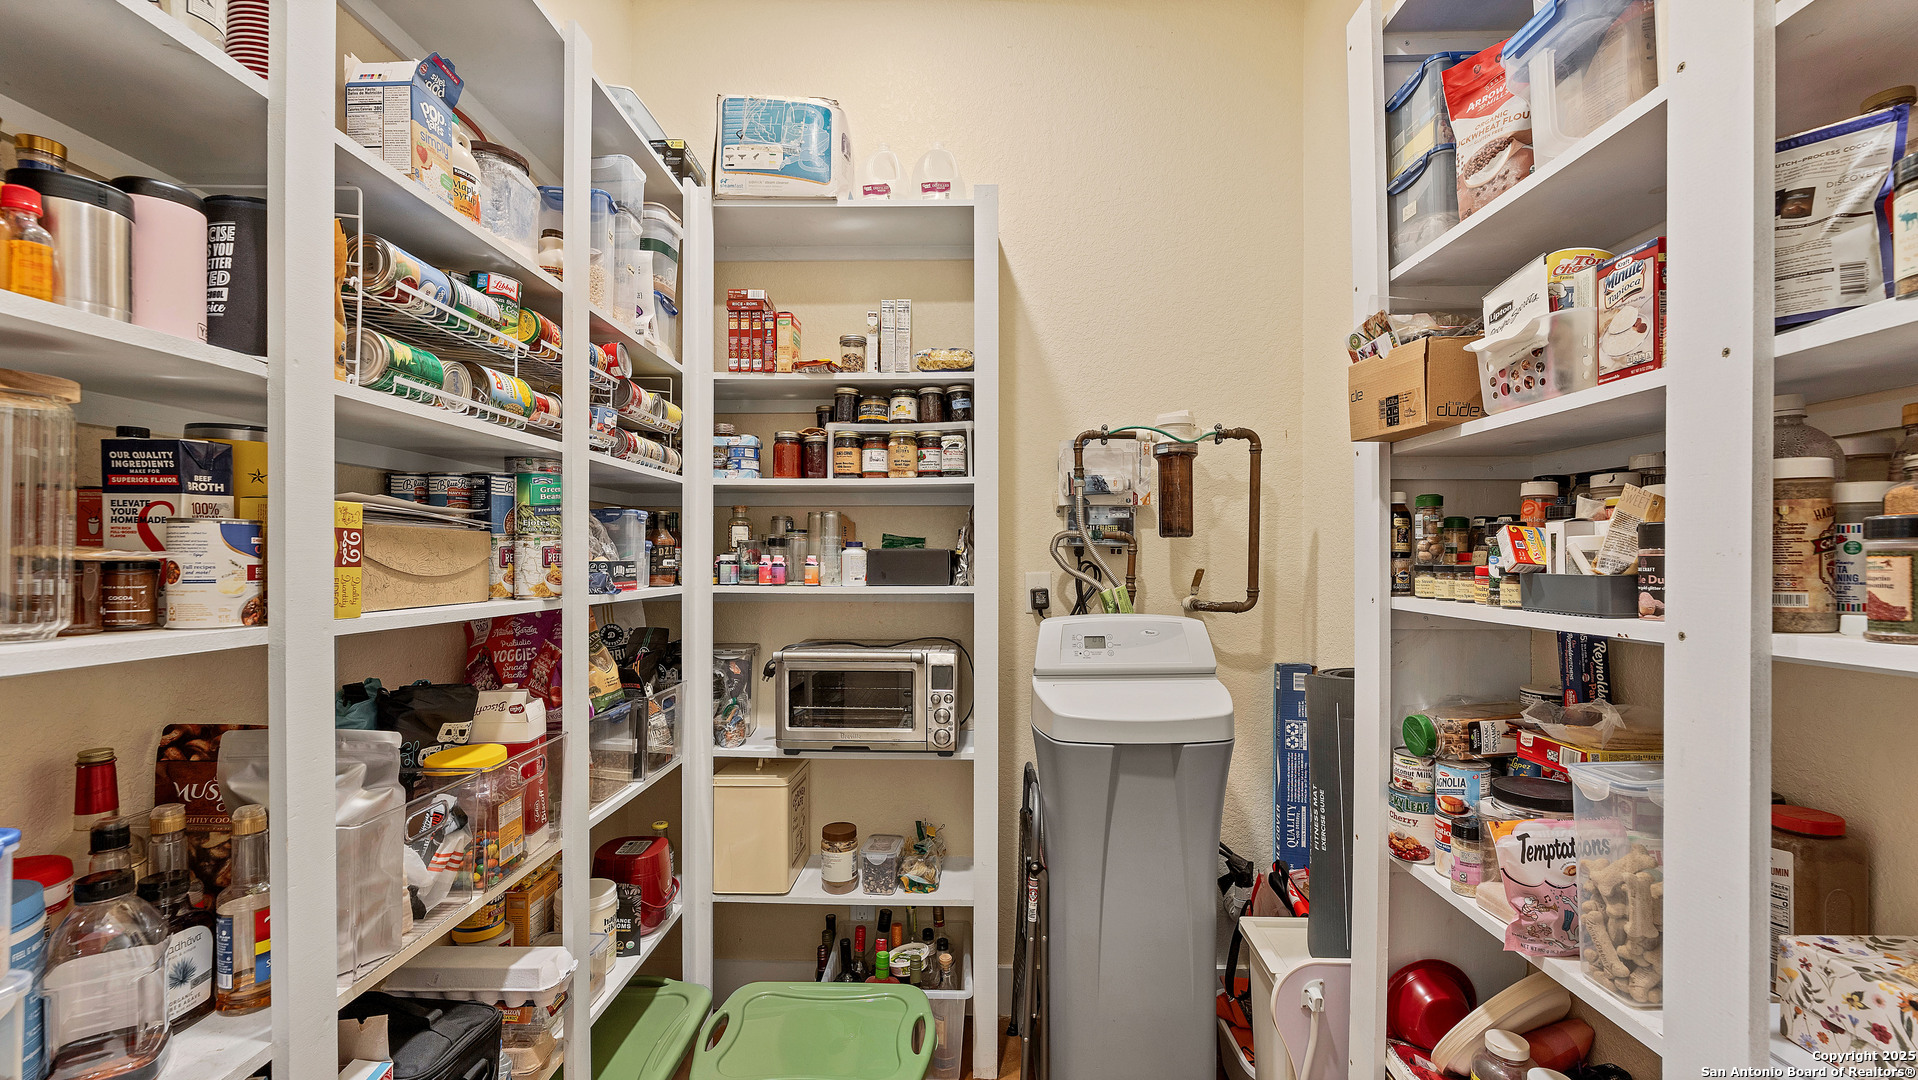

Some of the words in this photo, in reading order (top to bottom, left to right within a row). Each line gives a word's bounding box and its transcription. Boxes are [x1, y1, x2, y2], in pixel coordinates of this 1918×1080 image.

[1475, 110, 1508, 131] ORGANIC
[1502, 111, 1531, 125] FLOU
[420, 131, 449, 160] simply
[1843, 140, 1874, 152] COCOA
[453, 178, 477, 196] Maple
[453, 188, 477, 207] Syrup
[213, 242, 235, 257] YOU
[1572, 254, 1606, 266] Ton
[1617, 259, 1631, 269] Kraft
[207, 270, 231, 286] ED
[1604, 260, 1644, 293] Minute
[1607, 278, 1641, 304] Tapioca
[1489, 304, 1512, 323] Lipton
[1436, 402, 1480, 417] dude
[109, 451, 131, 459] OUR
[132, 451, 174, 459] QUALITY
[111, 460, 175, 468] INGREDIENTS
[187, 481, 225, 492] BROTH
[110, 499, 151, 507] ELEVATE
[1621, 490, 1650, 509] SWEET
[110, 507, 138, 516] YOUR
[191, 502, 220, 515] 100%
[110, 516, 167, 524] HOMEMADE
[522, 519, 550, 528] Ejotes
[501, 639, 531, 647] Probiotic
[493, 647, 538, 663] YOGGIES
[503, 662, 528, 671] Snack
[1592, 641, 1609, 699] Reynolds
[503, 671, 527, 679] Packs
[1417, 771, 1433, 779] Milk
[1405, 797, 1429, 813] LEAF
[1389, 810, 1418, 827] Cherry
[1287, 804, 1298, 848] QUALITY
